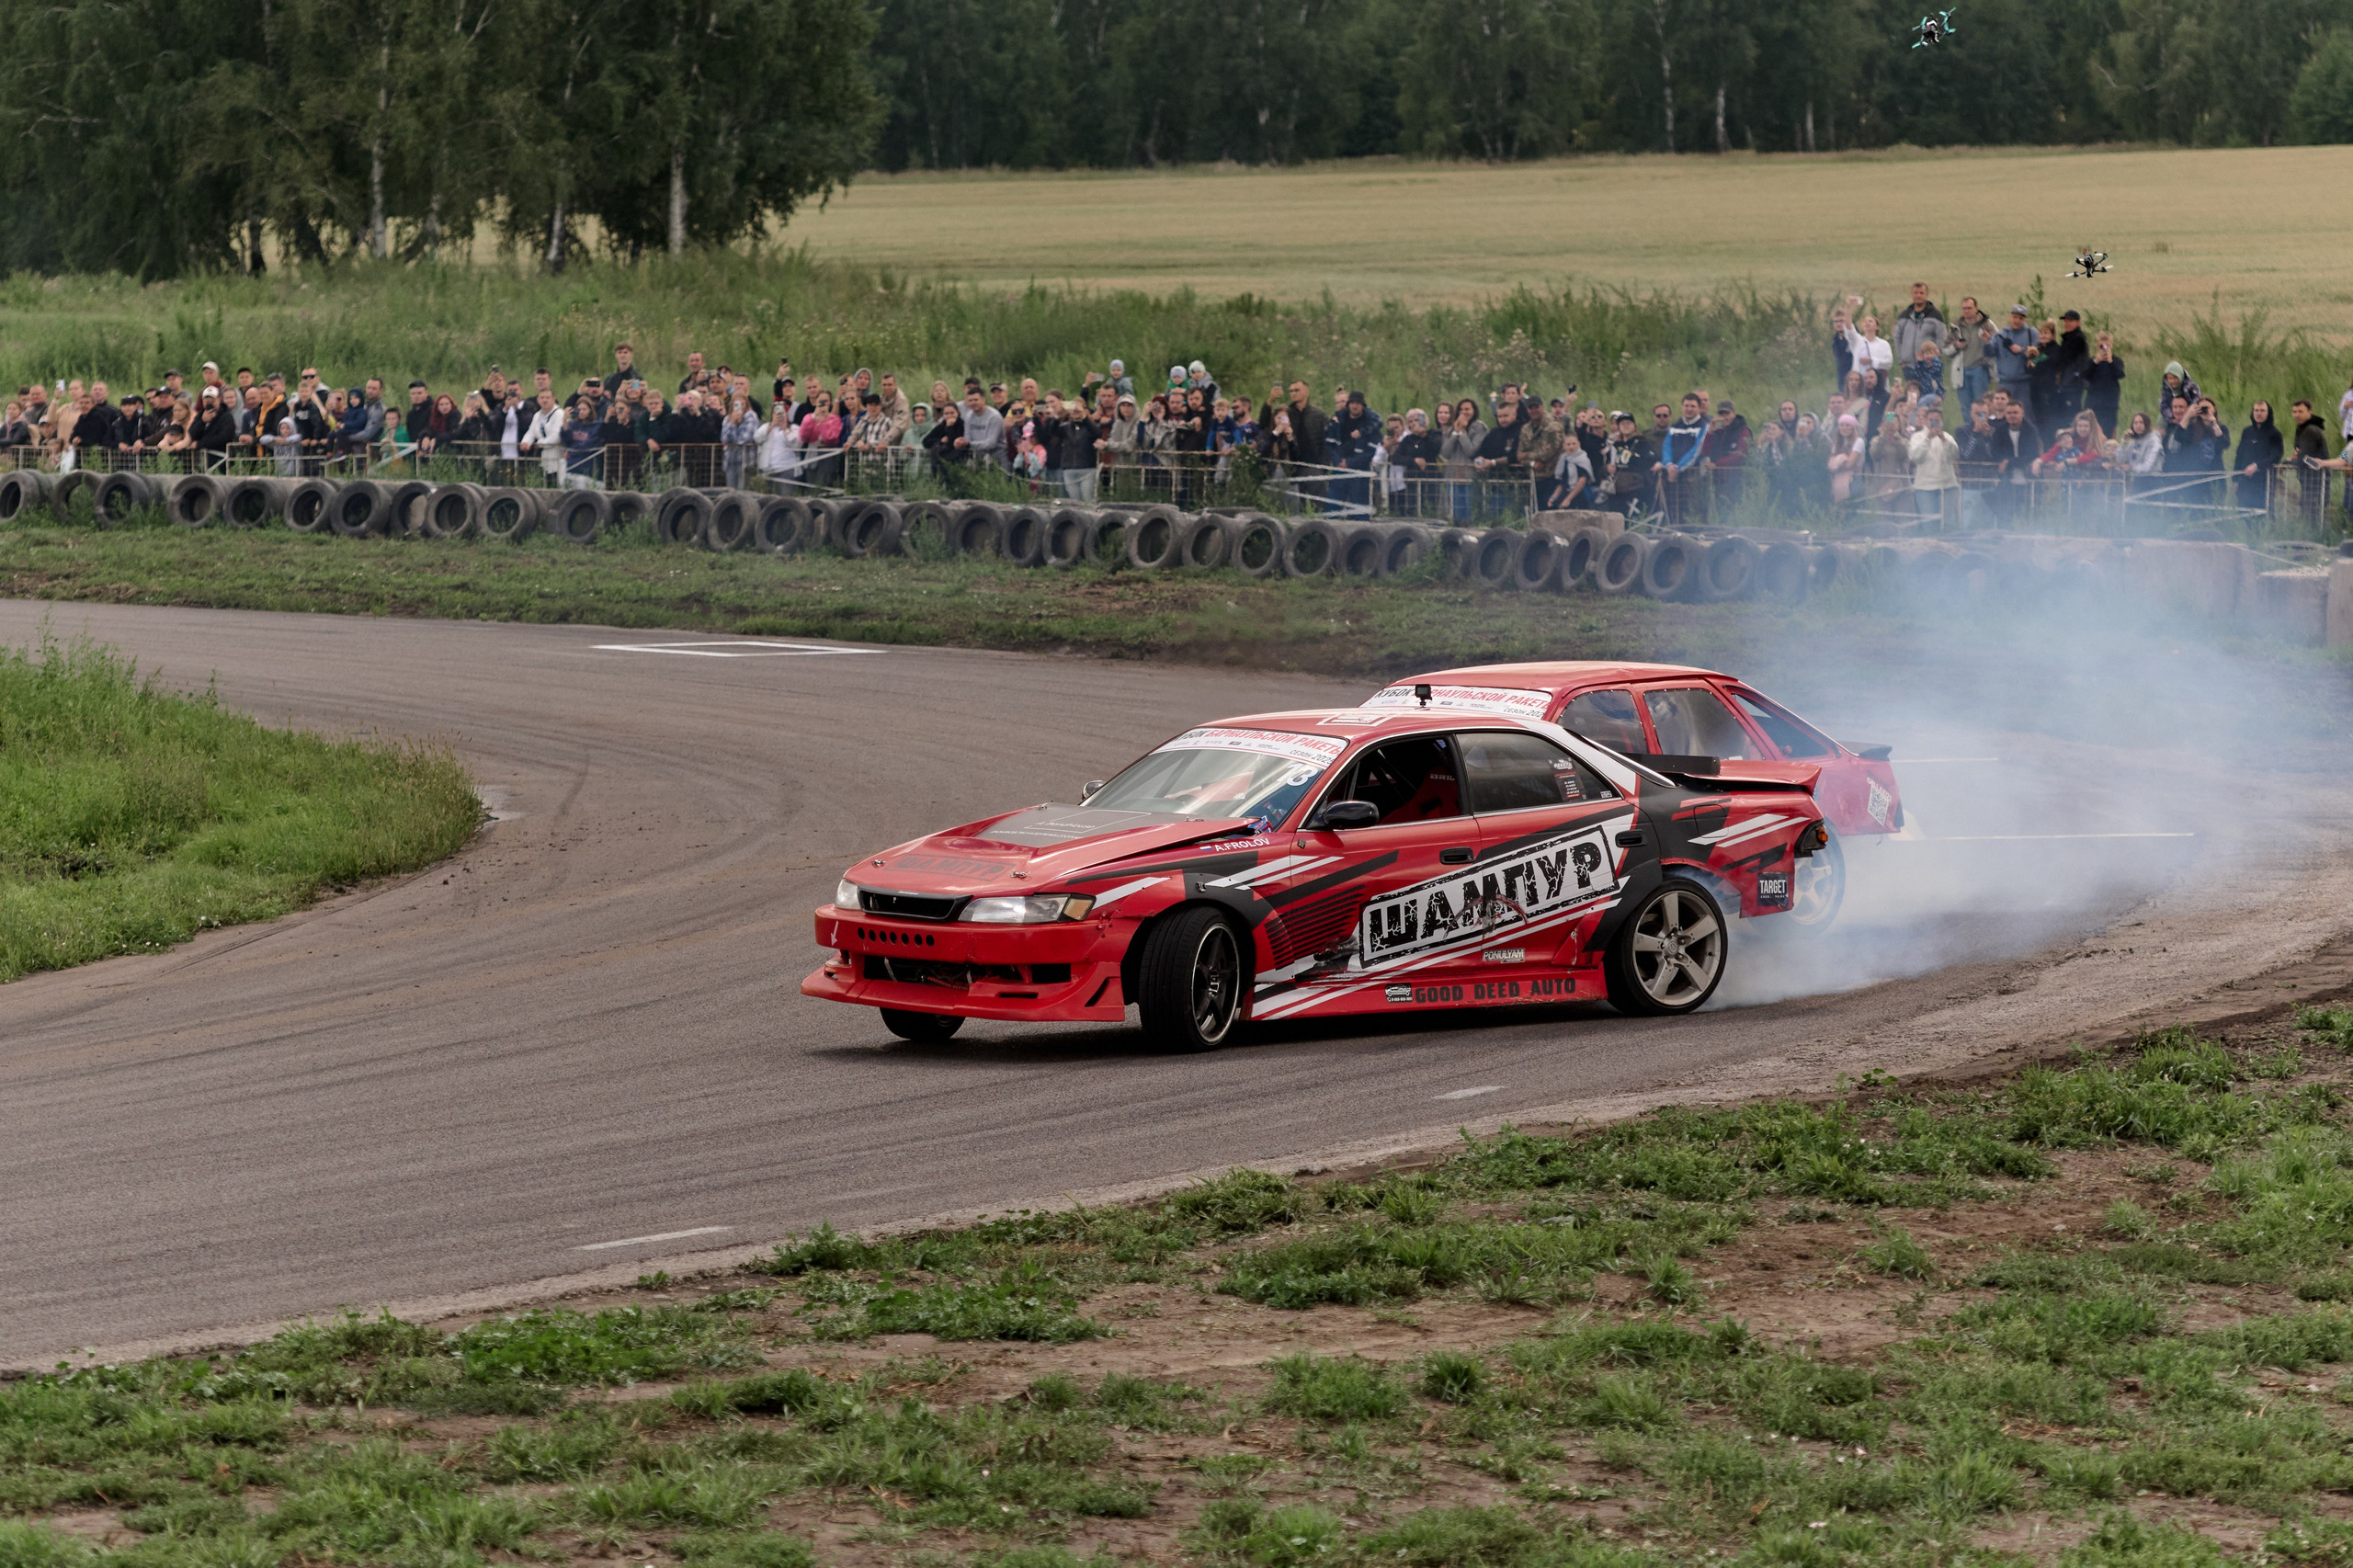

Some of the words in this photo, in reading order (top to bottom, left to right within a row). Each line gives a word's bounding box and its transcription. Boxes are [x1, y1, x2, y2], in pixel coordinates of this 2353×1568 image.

[1373, 688, 1415, 699] КУБОК
[1412, 688, 1507, 702] РНАУЛЬСКОЙ
[1503, 707, 1527, 715] СЕЗОН
[1526, 710, 1546, 718] 202
[1204, 729, 1299, 744] БАРНАУЛЬСКОЙ
[1289, 749, 1313, 759] СЕЗОН
[1277, 762, 1318, 787] 13
[1214, 837, 1270, 852] A.FROLOV
[896, 856, 1006, 878] ШАМПУР
[1759, 879, 1787, 894] TARGET
[1368, 840, 1603, 953] ШАМПУР
[1415, 985, 1464, 1004] GOOD
[1473, 982, 1520, 1000] DEED
[1529, 977, 1576, 996] AUTO
